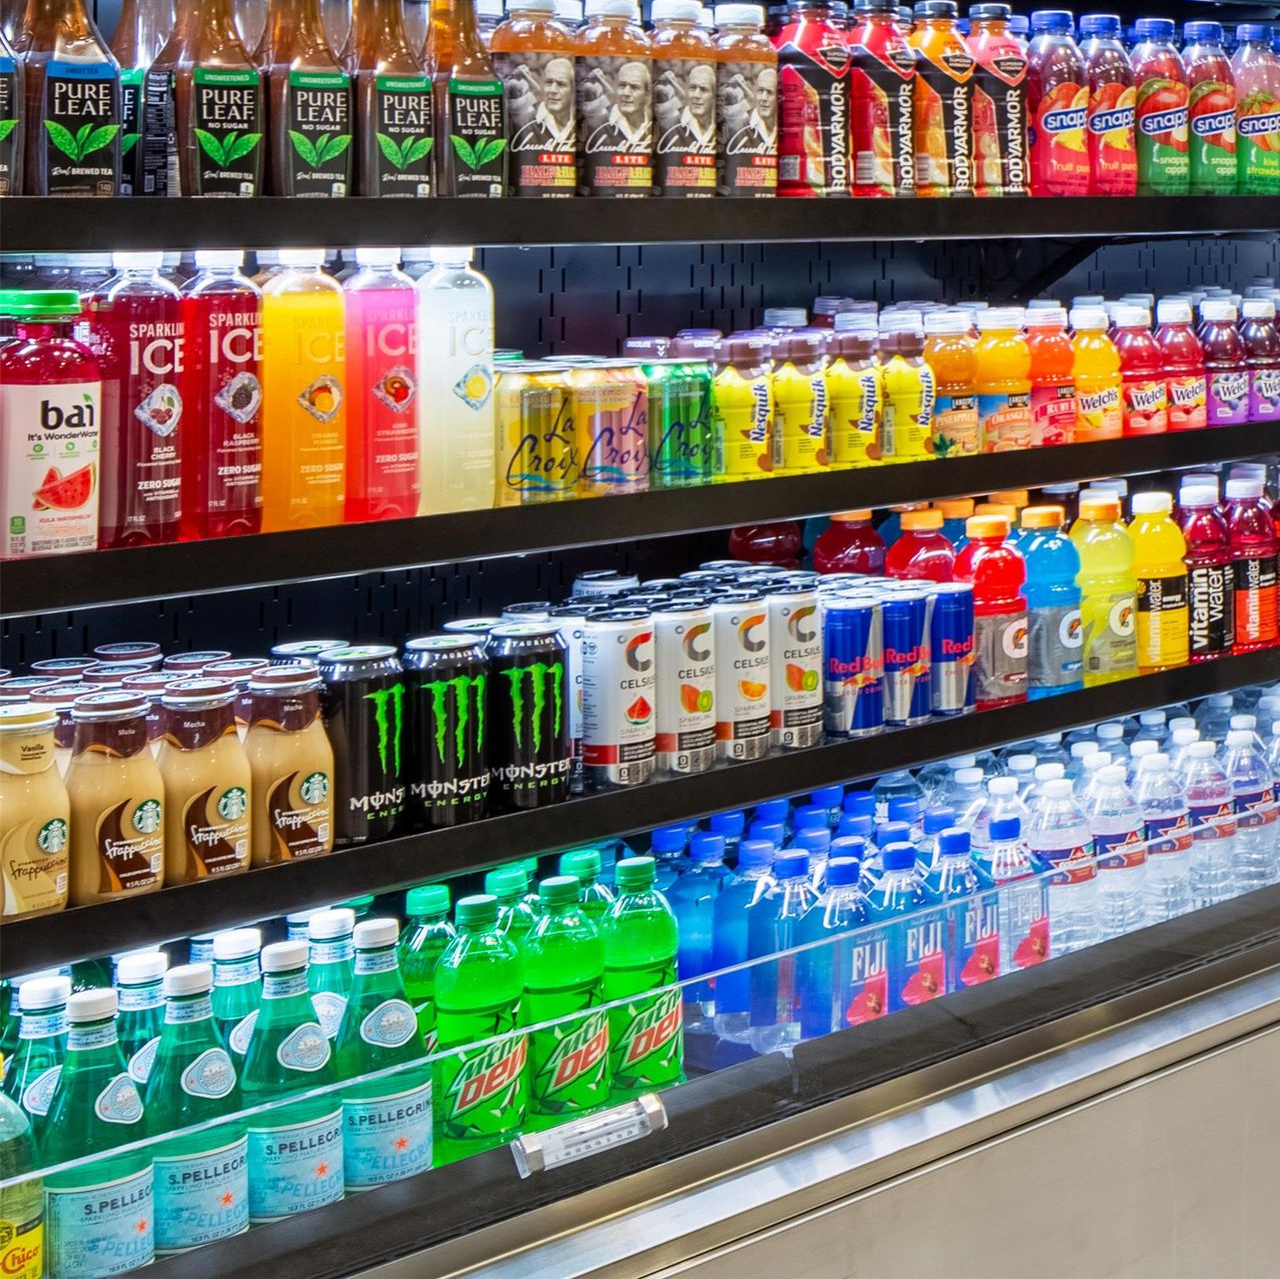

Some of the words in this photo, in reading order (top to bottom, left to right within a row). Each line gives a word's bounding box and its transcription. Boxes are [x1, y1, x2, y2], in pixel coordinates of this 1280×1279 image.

[54, 82, 112, 99] PURE
[202, 89, 254, 105] PURE
[296, 92, 347, 107] PURE
[383, 95, 431, 109] PURE
[456, 98, 501, 113] PURE
[830, 81, 846, 190] BODYARMOR
[899, 83, 914, 189] BODYARMOR
[953, 86, 969, 191] BODYARMOR
[1006, 88, 1024, 193] BODYARMOR
[542, 155, 570, 163] LITE
[615, 155, 643, 164] LITE
[686, 156, 712, 164] LITE
[71, 167, 100, 175] BREWED
[101, 167, 113, 175] TEA
[209, 328, 264, 363] ICE
[365, 323, 417, 357] ICE
[129, 338, 185, 375] ICE
[859, 374, 878, 432] Nesquik
[918, 369, 935, 426] Nesquik
[1081, 390, 1118, 412] Welch's
[41, 398, 95, 430] bai
[750, 383, 771, 443] Nesquik
[809, 378, 828, 437] Nesquik
[543, 397, 576, 444] La
[28, 433, 42, 441] It's
[150, 452, 176, 461] CHERRY
[375, 455, 398, 463] ZERO
[506, 434, 579, 487] Croix
[217, 466, 241, 476] ZERO
[137, 481, 162, 490] ZERO
[1208, 569, 1223, 621] water
[1190, 567, 1209, 649] vitamin
[941, 638, 972, 654] Red
[886, 647, 918, 664] Red
[829, 657, 861, 674] Red
[183, 720, 205, 728] Mocha
[20, 743, 44, 753] Vanilla
[503, 775, 566, 790] ENERGY
[424, 790, 488, 807] ENERGY
[964, 903, 999, 944] FIJI
[906, 920, 942, 962] FIJI
[851, 939, 888, 981] FIJI
